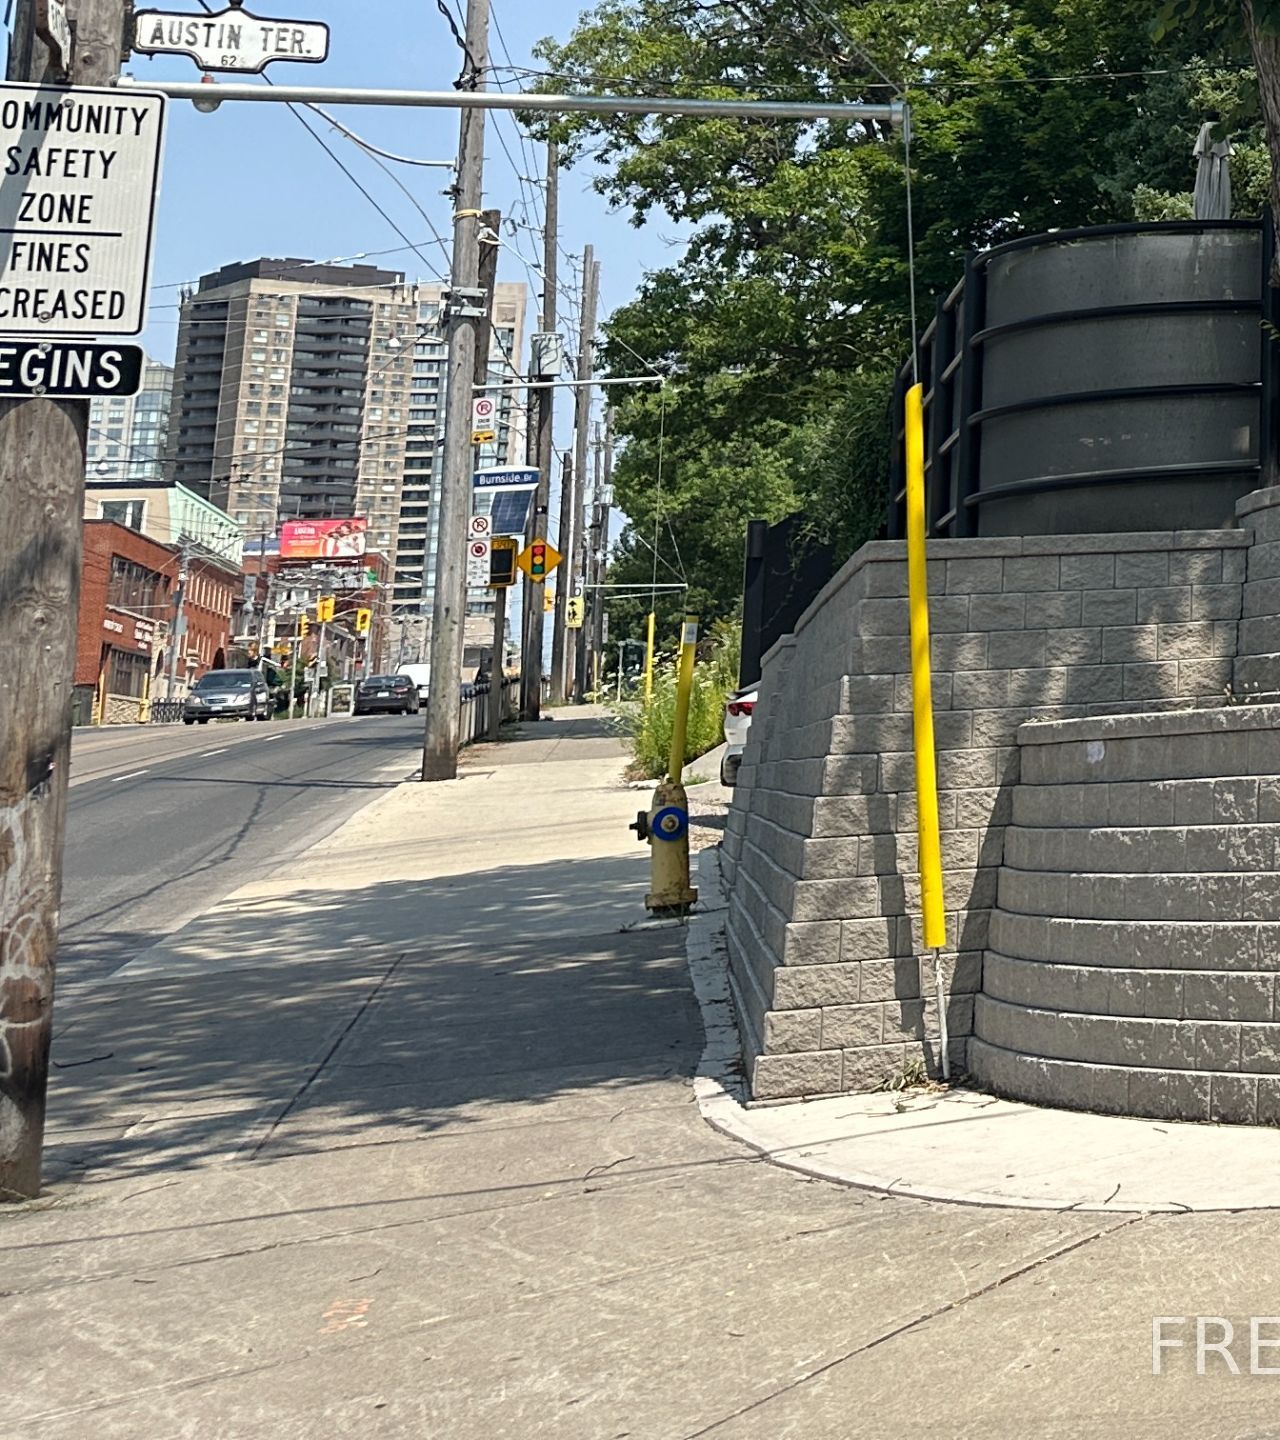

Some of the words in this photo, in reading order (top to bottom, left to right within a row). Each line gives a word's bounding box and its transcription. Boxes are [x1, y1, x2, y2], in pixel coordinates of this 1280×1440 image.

[150, 19, 243, 50] AUSTIN
[260, 26, 312, 54] TER.
[1, 100, 149, 136] OMMUNITY
[5, 146, 117, 179] SAFETY
[18, 192, 94, 224] ZONE
[10, 241, 91, 273] FINES
[0, 287, 126, 320] CREASED
[0, 347, 123, 389] EGINS
[480, 473, 520, 485] Burnside
